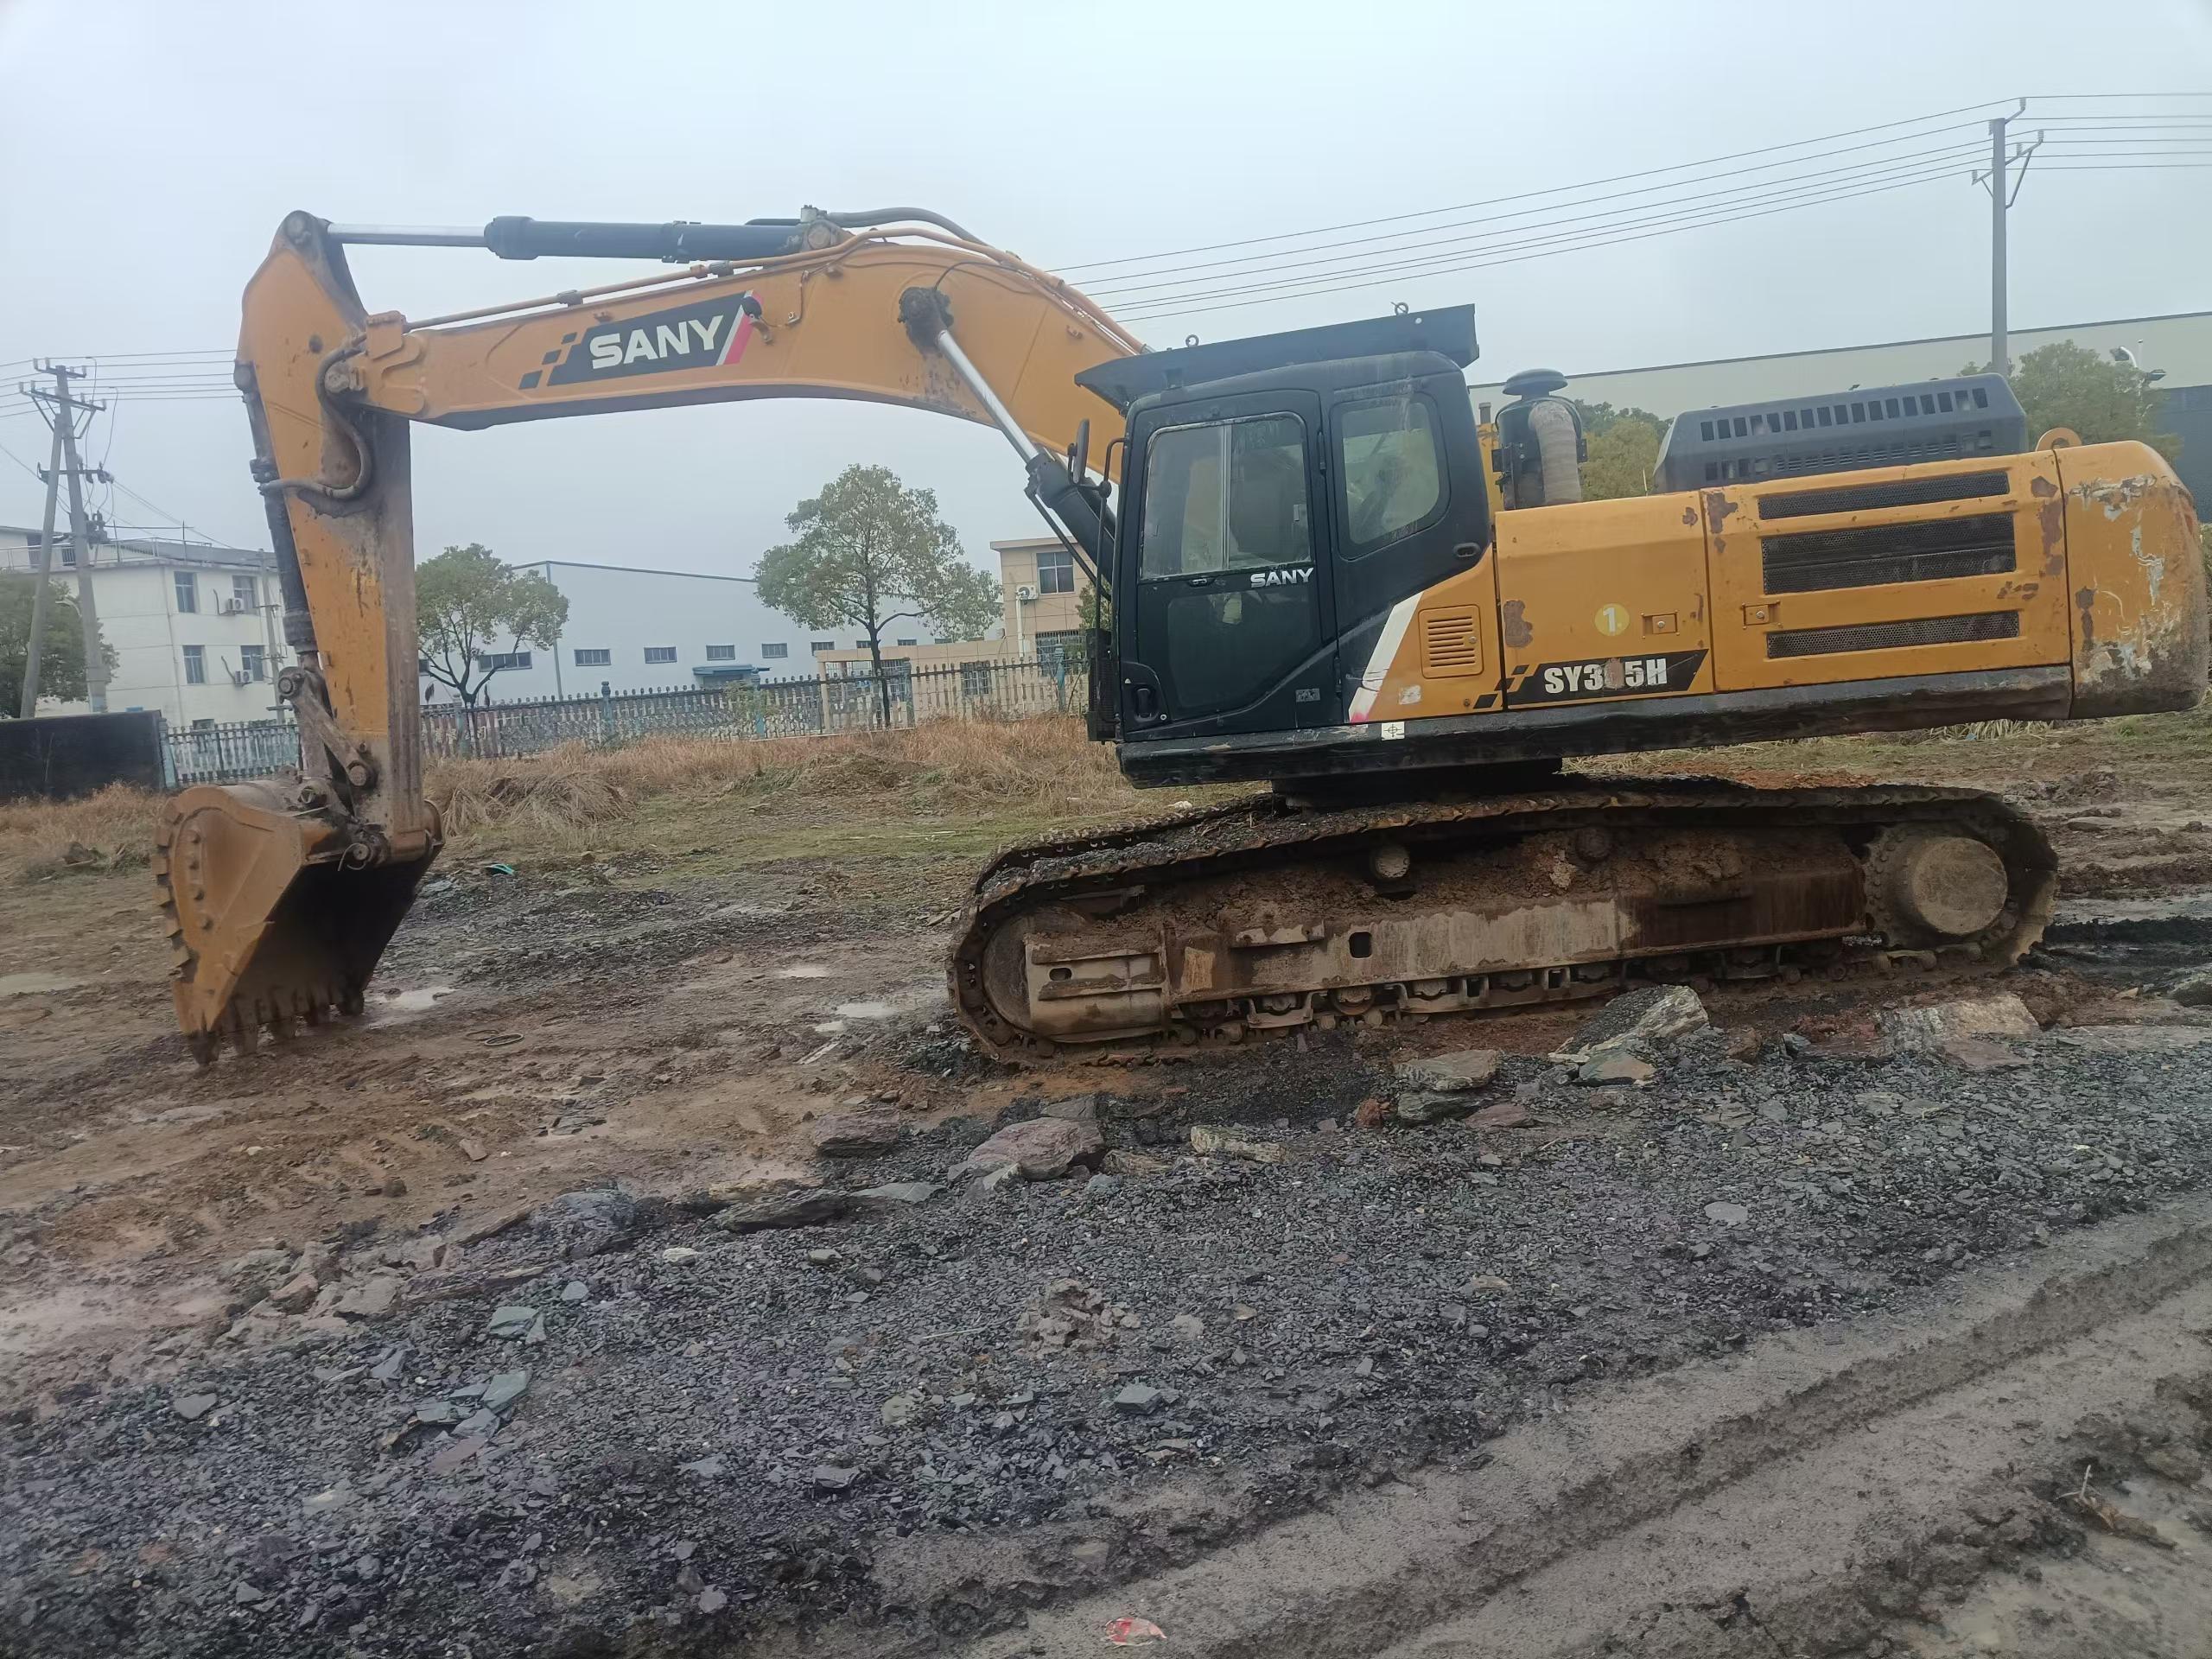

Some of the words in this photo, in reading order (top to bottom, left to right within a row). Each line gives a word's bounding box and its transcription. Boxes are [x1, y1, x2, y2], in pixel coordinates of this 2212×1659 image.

[589, 315, 724, 370] SANY
[1250, 567, 1313, 588] SANY
[1603, 607, 1617, 635] 1
[1544, 658, 1668, 694] SY35H
